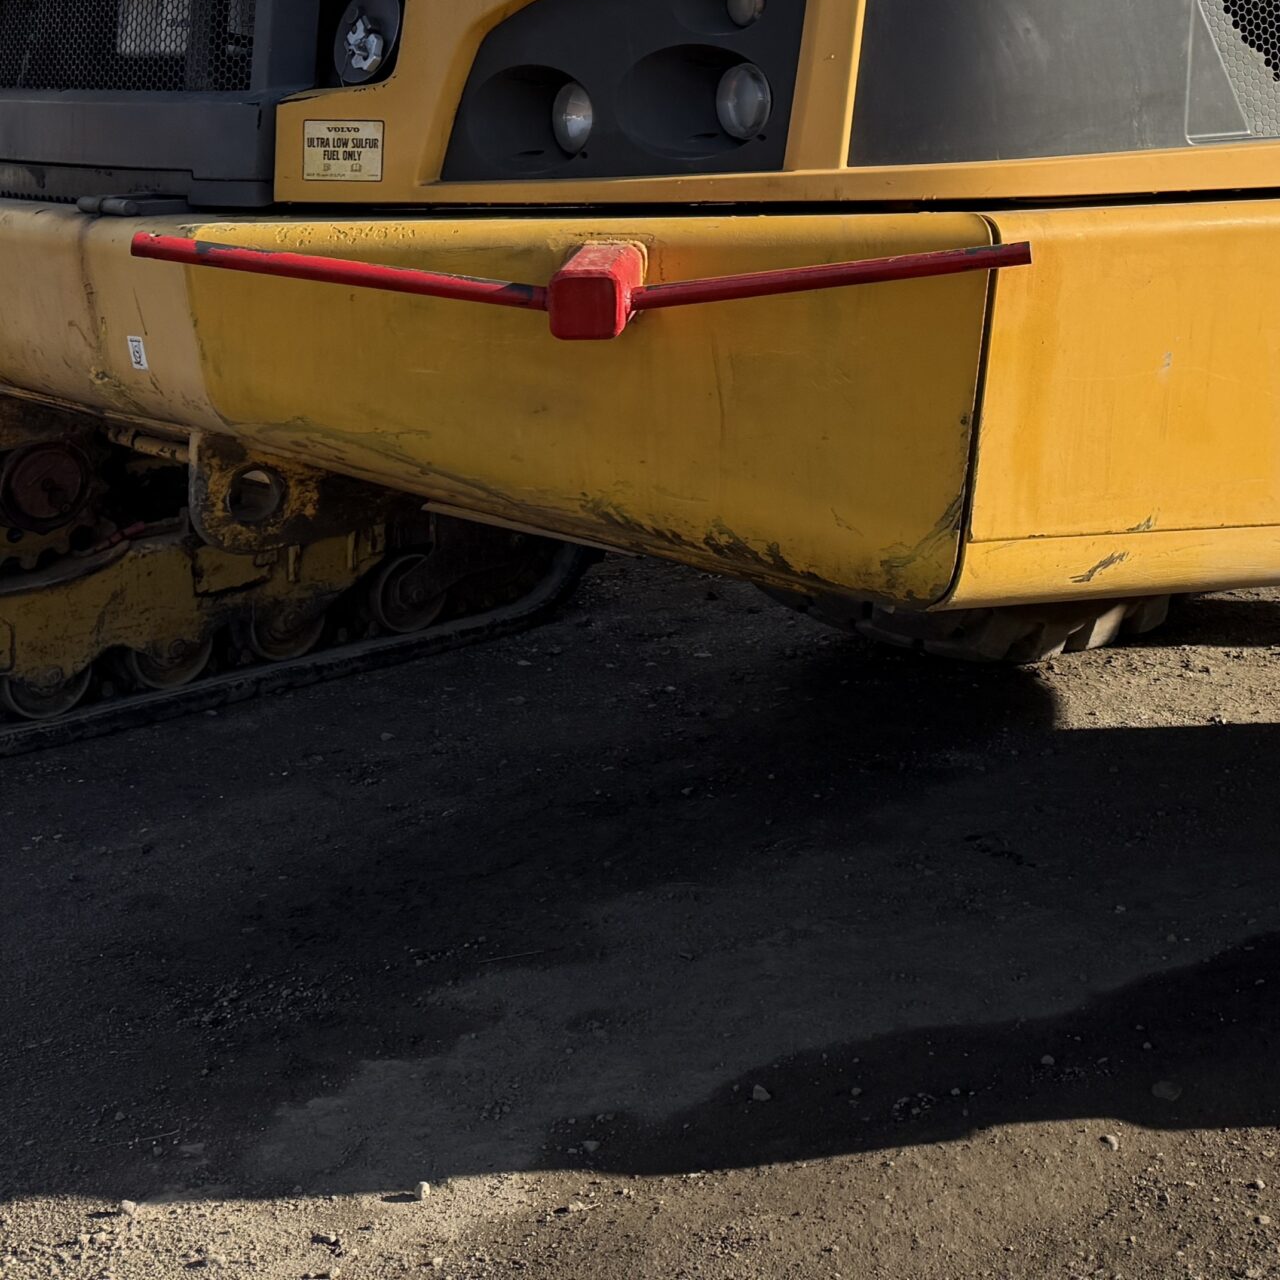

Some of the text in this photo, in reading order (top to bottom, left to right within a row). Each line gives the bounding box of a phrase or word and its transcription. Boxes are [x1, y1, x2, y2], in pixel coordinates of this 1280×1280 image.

[307, 137, 380, 150] ULTRA LOW SULFUR
[323, 150, 362, 161] FUEL ONLY
